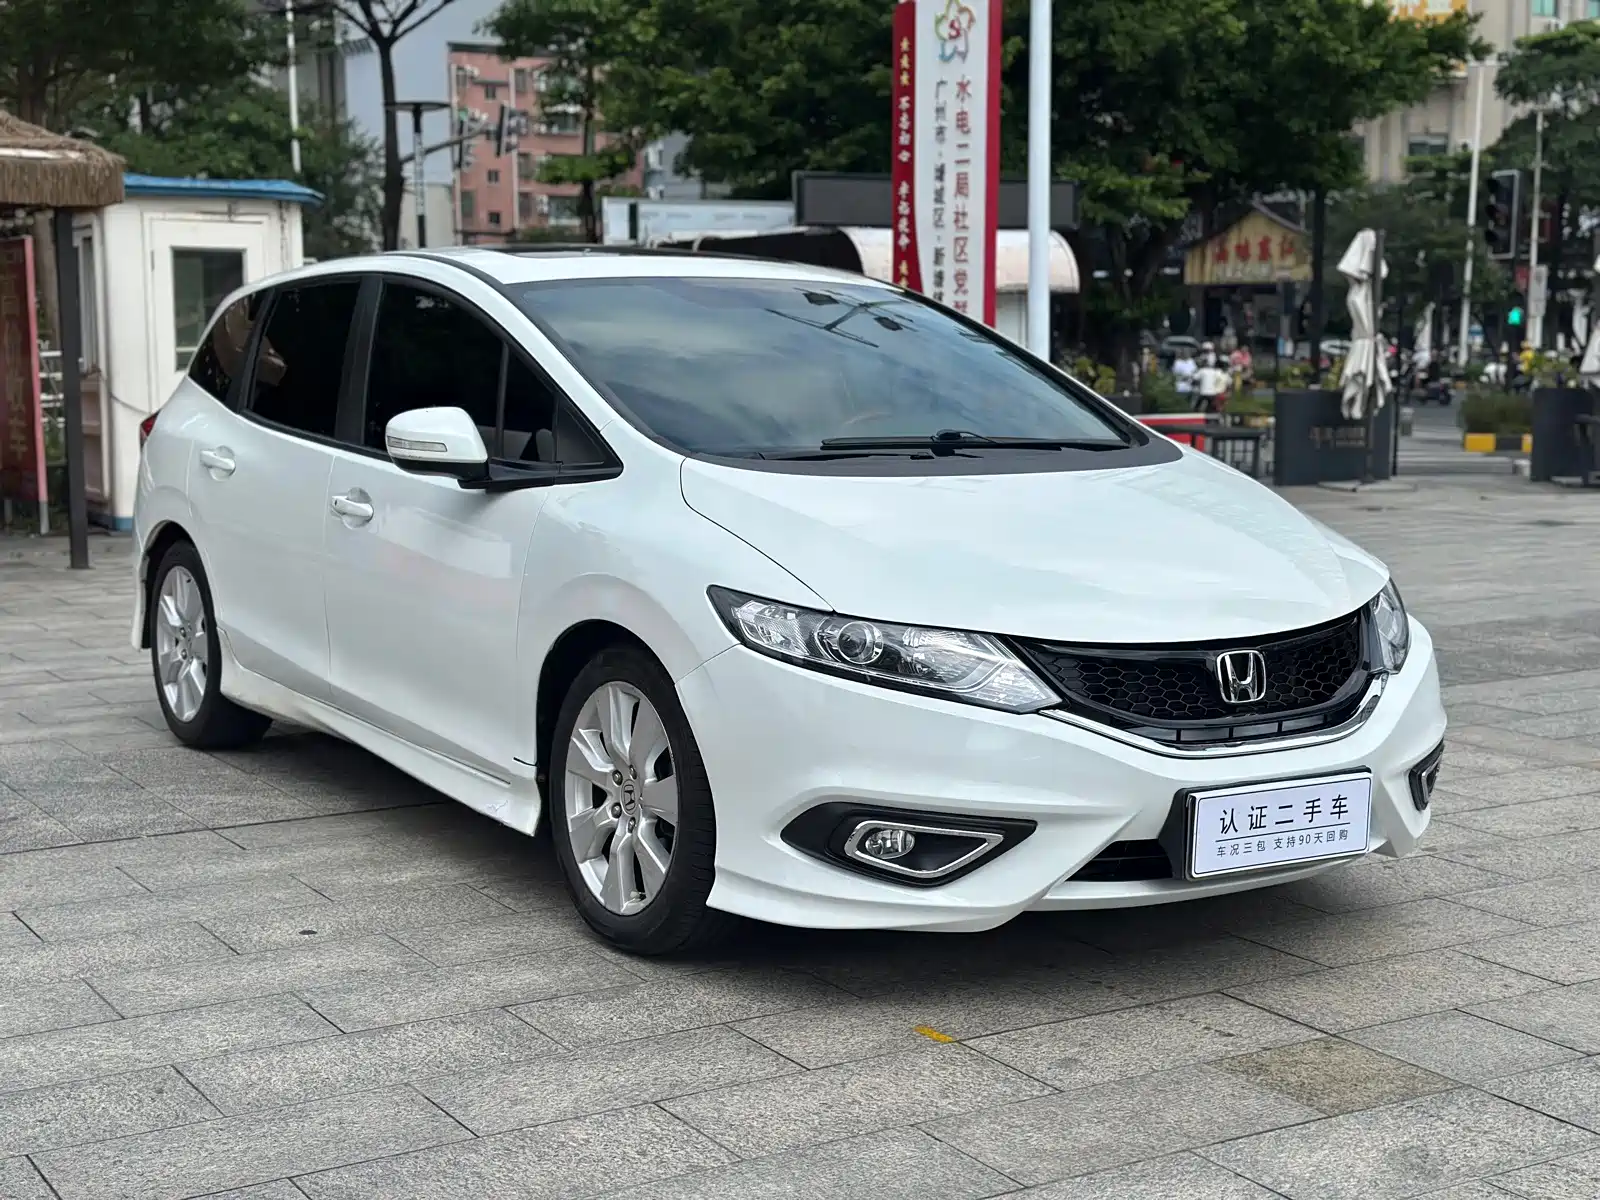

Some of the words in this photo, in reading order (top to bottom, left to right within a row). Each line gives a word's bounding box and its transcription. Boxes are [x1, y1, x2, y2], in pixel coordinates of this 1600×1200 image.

[1219, 793, 1349, 835] 认证二手车
[1216, 839, 1266, 858] 车况三包
[1273, 828, 1349, 850] 支持90天回购
